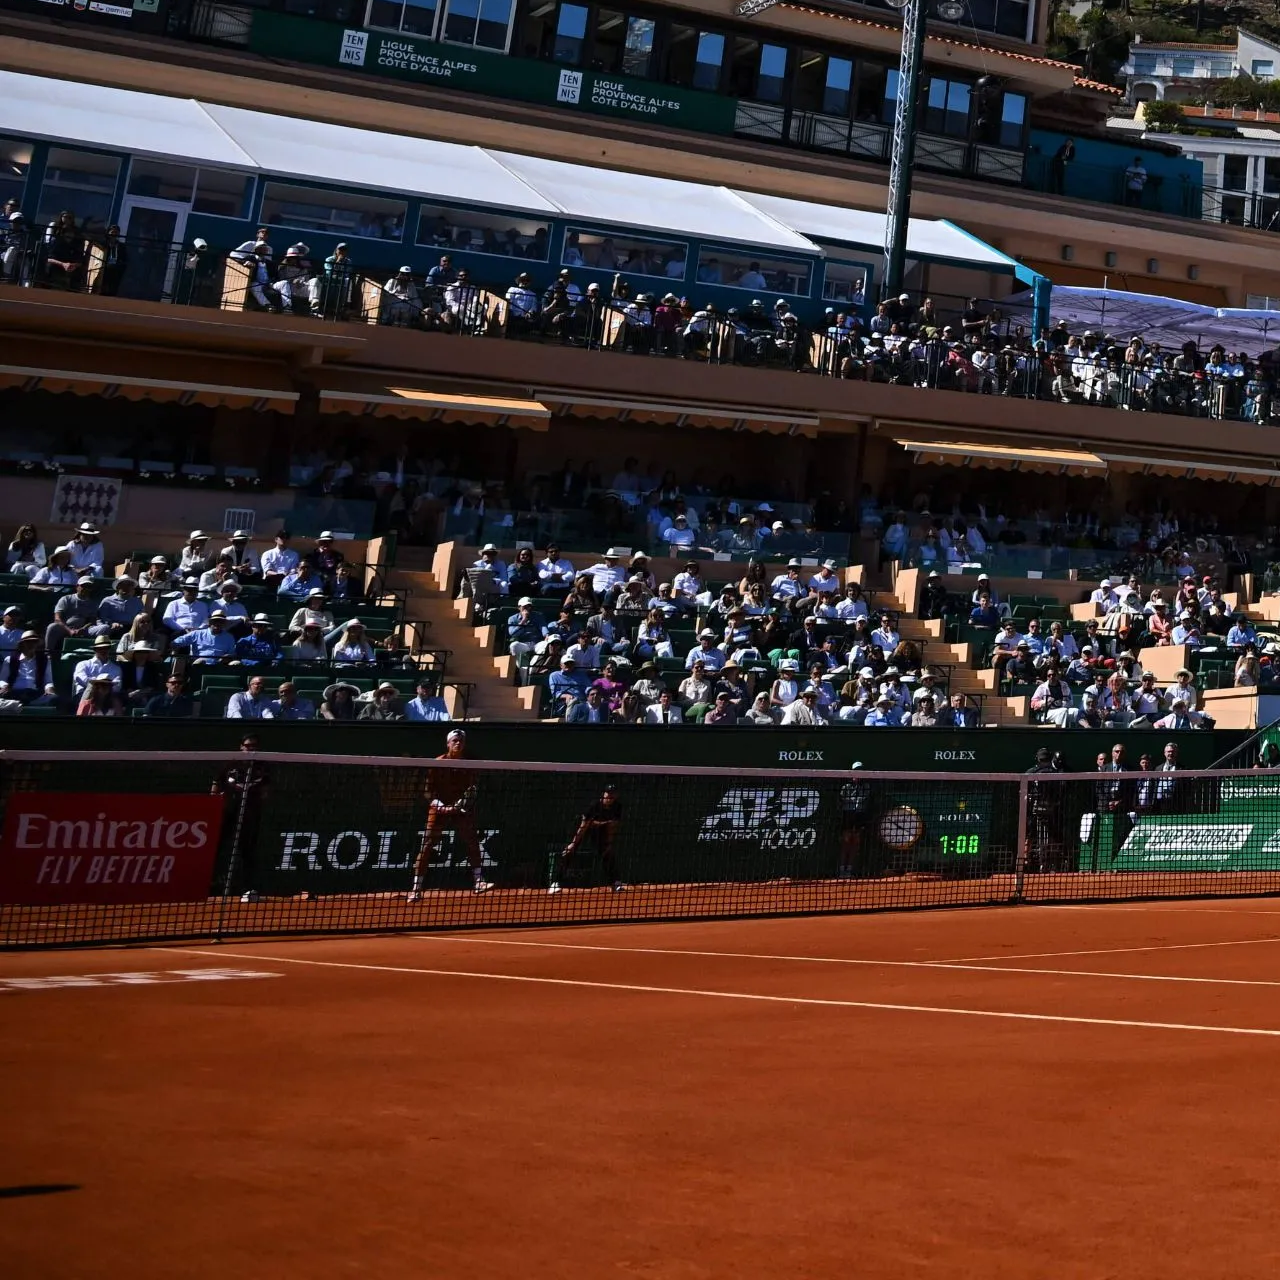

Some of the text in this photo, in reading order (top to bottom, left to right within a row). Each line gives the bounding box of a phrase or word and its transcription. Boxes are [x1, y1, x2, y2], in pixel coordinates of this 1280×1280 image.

[347, 34, 364, 46] TEN
[381, 40, 415, 52] LIGUE
[344, 50, 361, 61] NIS
[380, 48, 477, 73] PROVENCE ALPES
[410, 63, 452, 77] D'AZUR
[563, 74, 578, 85] TEN
[594, 80, 624, 92] LIGUE
[561, 89, 576, 99] NIS
[593, 87, 680, 109] PROVENCE ALPES
[620, 101, 657, 114] D'AZUR
[778, 751, 824, 761] ROLEX
[934, 751, 976, 760] ROLEX
[16, 812, 208, 848] Emirates
[275, 830, 500, 870] ROLEX
[940, 835, 979, 854] 1:08
[36, 855, 176, 884] FLY BETTER
